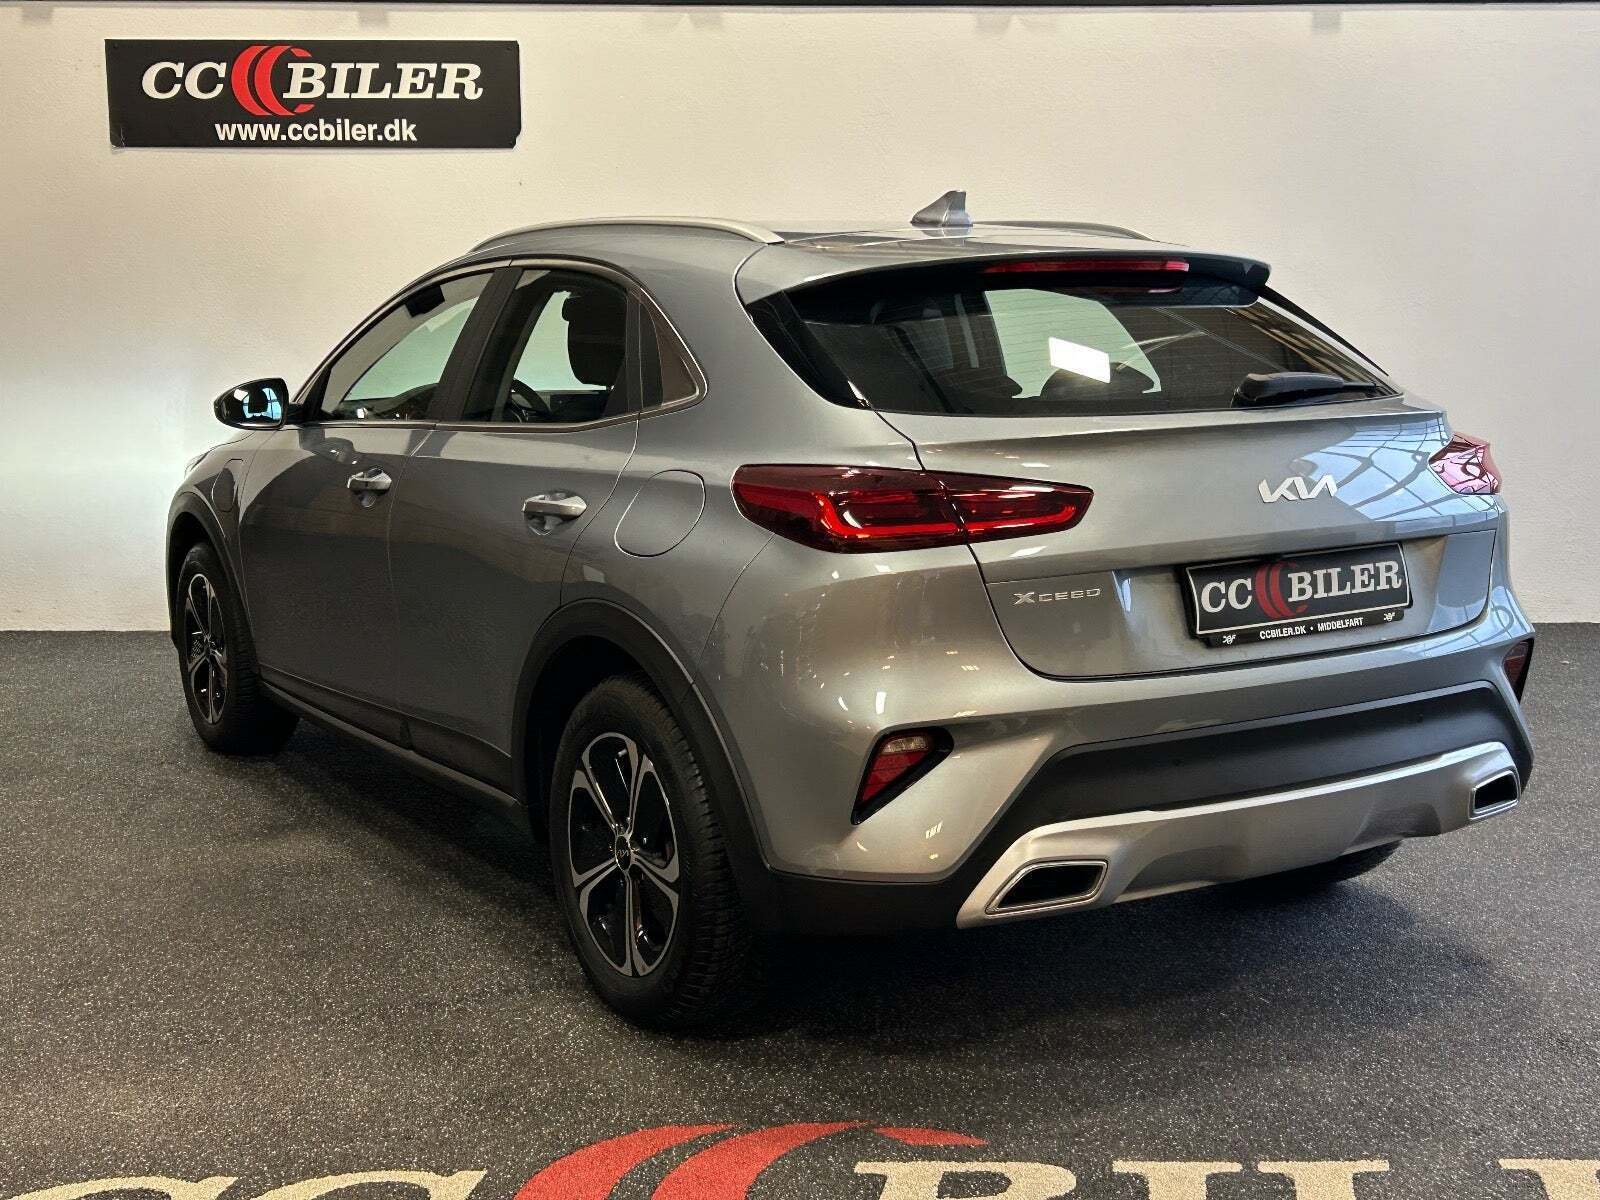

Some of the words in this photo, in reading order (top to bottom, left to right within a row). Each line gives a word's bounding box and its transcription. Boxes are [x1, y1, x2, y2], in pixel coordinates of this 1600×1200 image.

[141, 61, 228, 100] CC
[282, 62, 484, 101] BILER
[214, 118, 418, 143] www.ccbiler.dk
[1258, 474, 1338, 503] KIA
[1200, 577, 1252, 614] CC
[1287, 560, 1402, 603] BILER
[1259, 624, 1307, 640] CCBILER.DK
[1317, 617, 1364, 632] MIDDELFART
